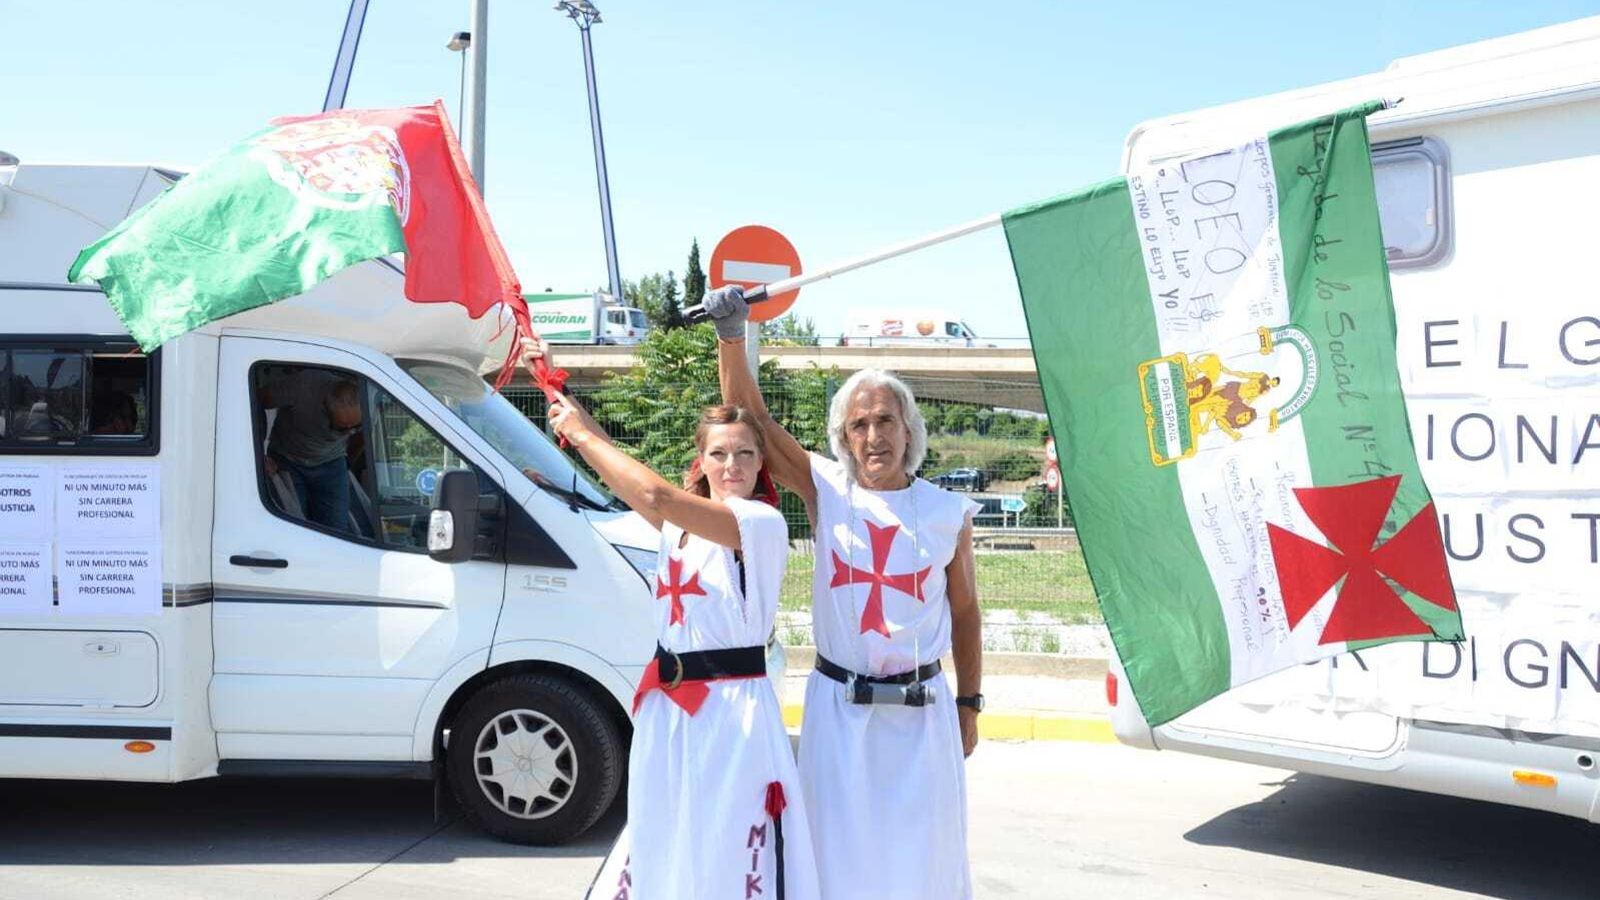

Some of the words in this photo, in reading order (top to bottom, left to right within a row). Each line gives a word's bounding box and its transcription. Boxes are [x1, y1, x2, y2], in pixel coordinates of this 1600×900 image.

[1325, 311, 1369, 407] Social
[1161, 378, 1171, 400] POR
[64, 483, 74, 491] NI
[75, 483, 89, 491] UN
[90, 483, 126, 491] MINUTO
[78, 497, 93, 506] SIN
[95, 497, 133, 506] CARRERA
[78, 510, 135, 519] PROFESIONAL
[65, 559, 75, 567] NI
[76, 559, 90, 567] UN
[92, 559, 127, 567] MINUTO
[79, 573, 94, 582] SIN
[95, 573, 134, 582] CARRERA
[78, 586, 136, 595] PROFESIONAL
